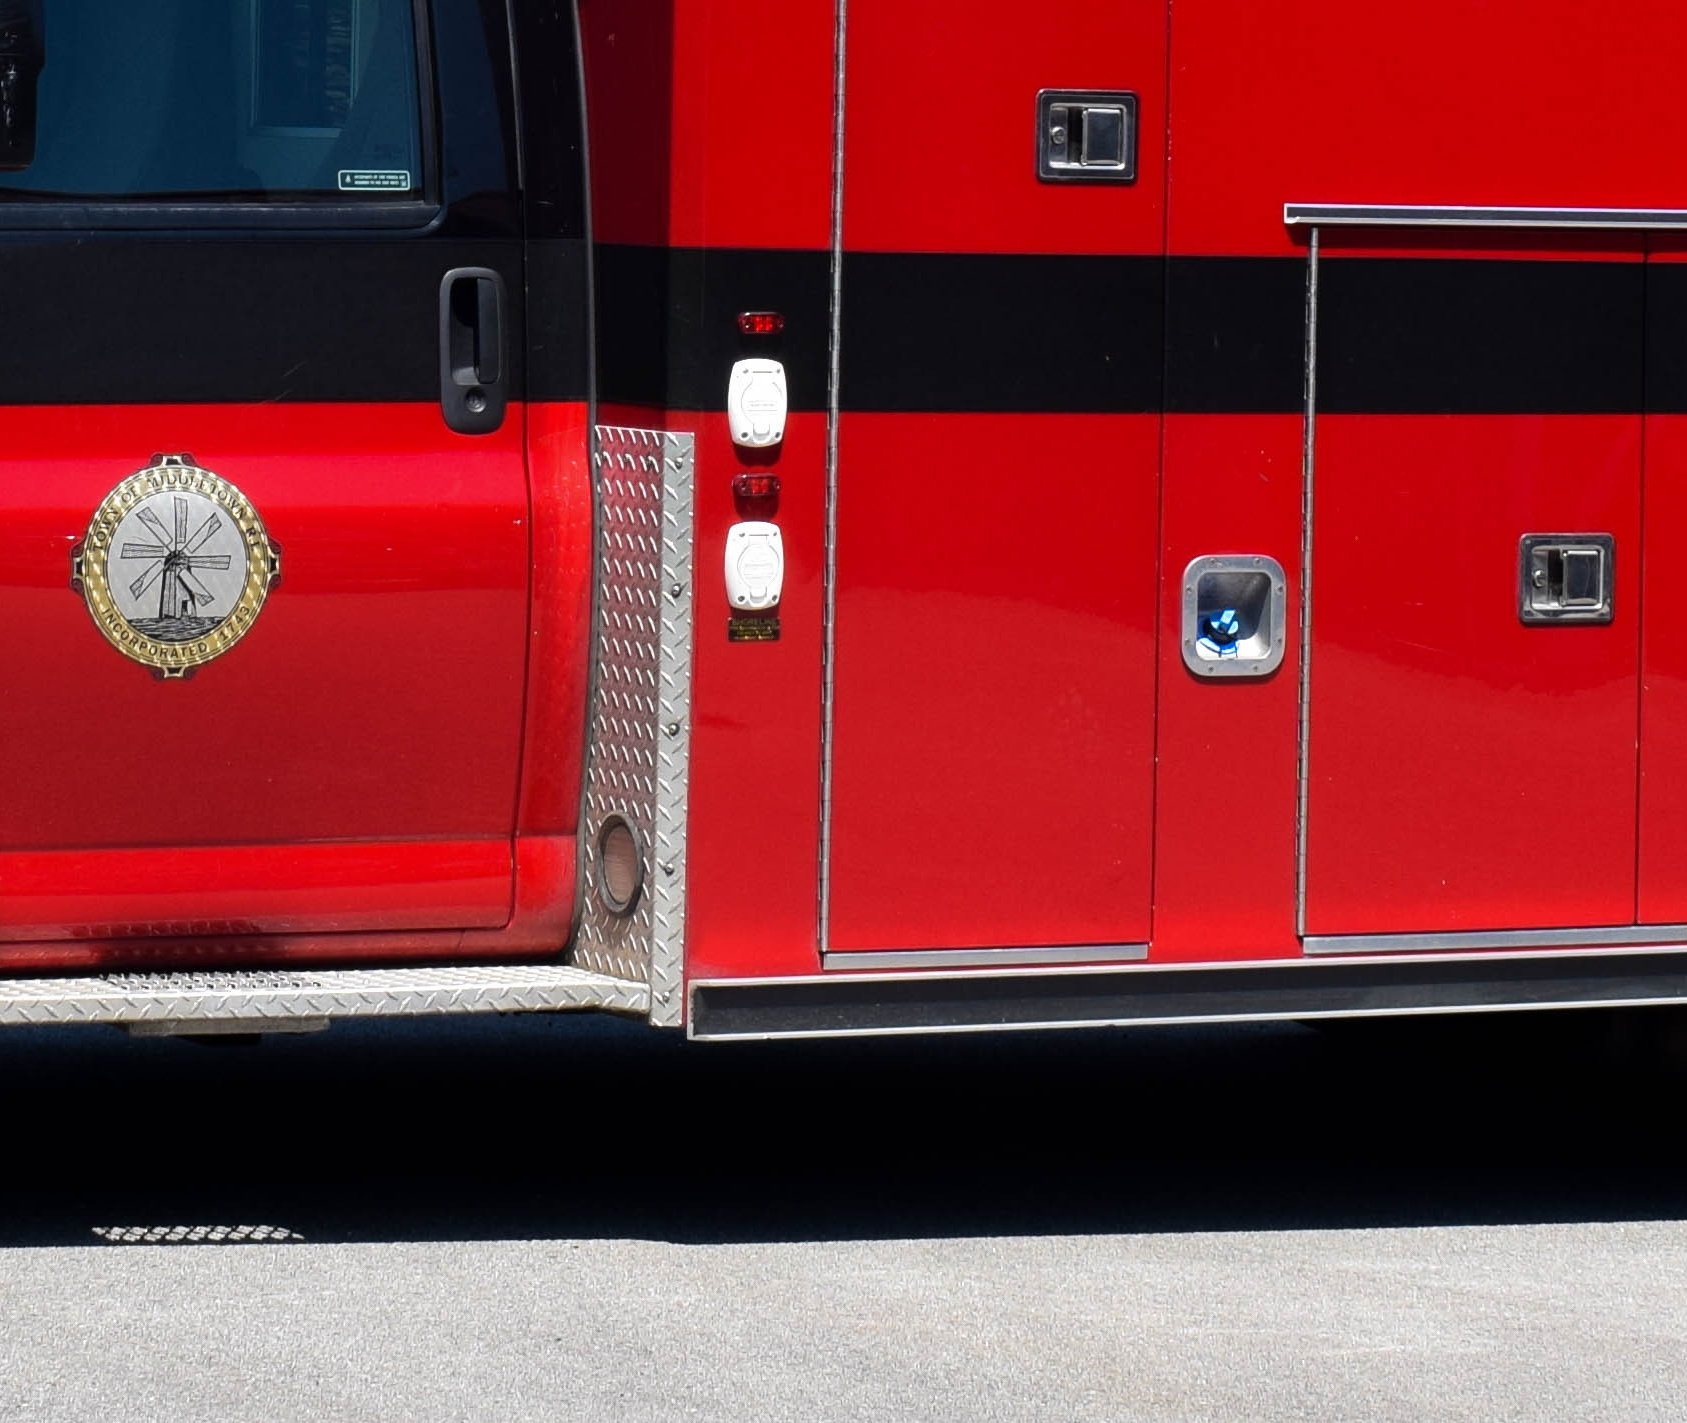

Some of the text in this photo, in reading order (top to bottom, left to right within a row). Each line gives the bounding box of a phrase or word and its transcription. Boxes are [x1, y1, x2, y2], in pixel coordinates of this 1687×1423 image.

[92, 506, 120, 552] TOWN
[121, 488, 139, 505] OF
[146, 472, 246, 521] MIDDLETOWN
[100, 605, 251, 660] INCORPORATED 1743
